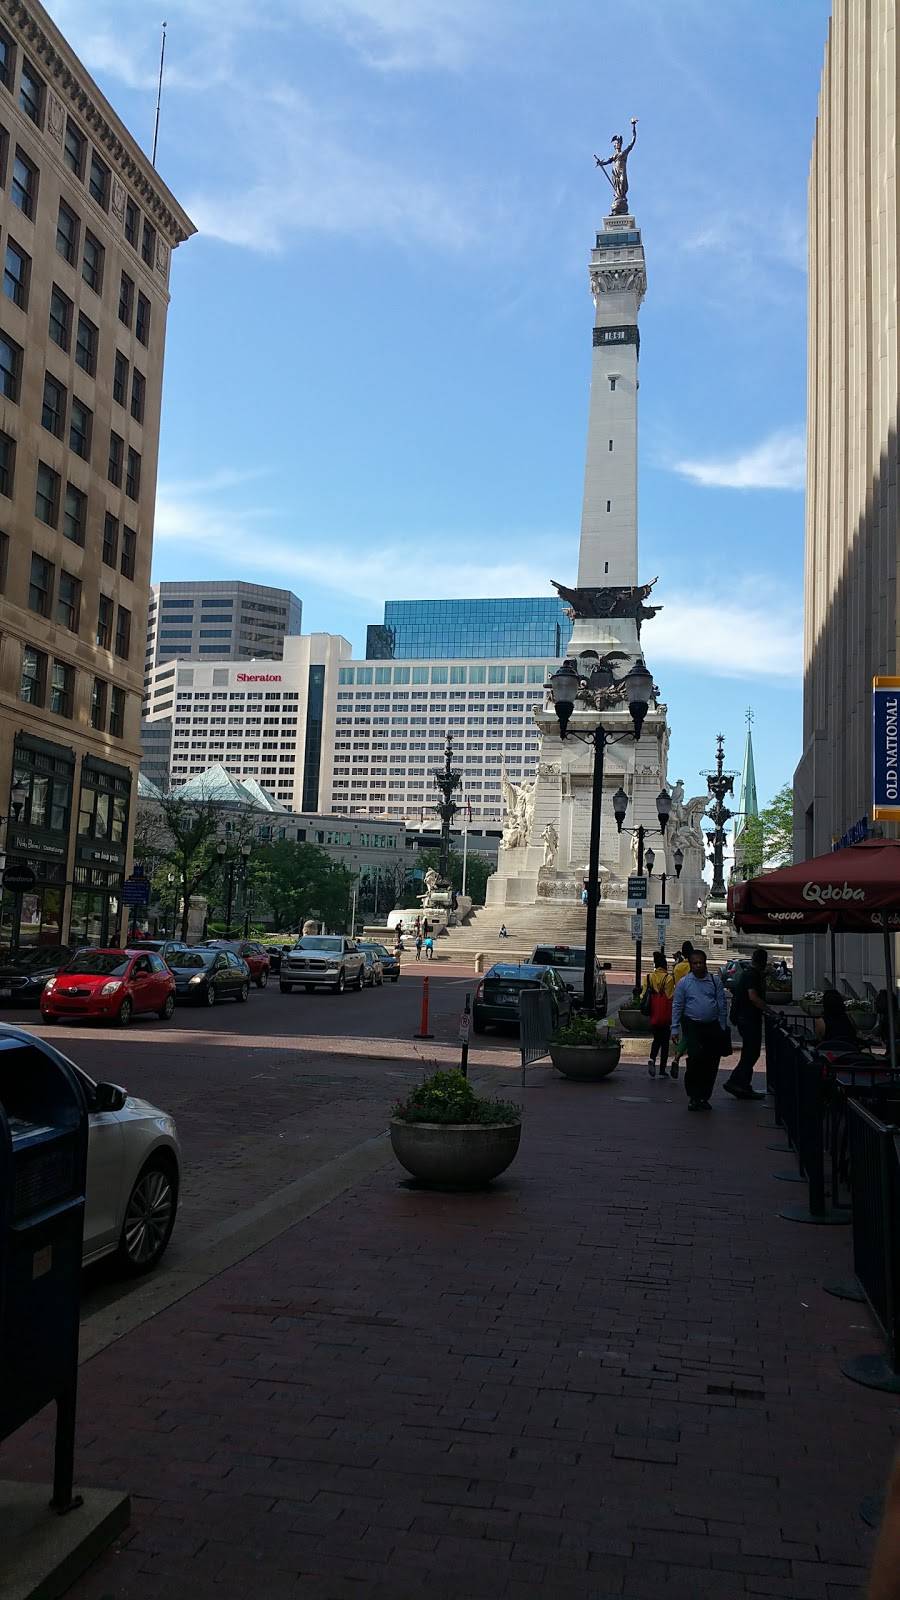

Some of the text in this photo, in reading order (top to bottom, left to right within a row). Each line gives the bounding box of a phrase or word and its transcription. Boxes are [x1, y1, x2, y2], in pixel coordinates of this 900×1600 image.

[237, 673, 282, 682] Sheraton
[886, 698, 898, 800] OLD NATIONAL
[802, 881, 865, 905] Qdoba
